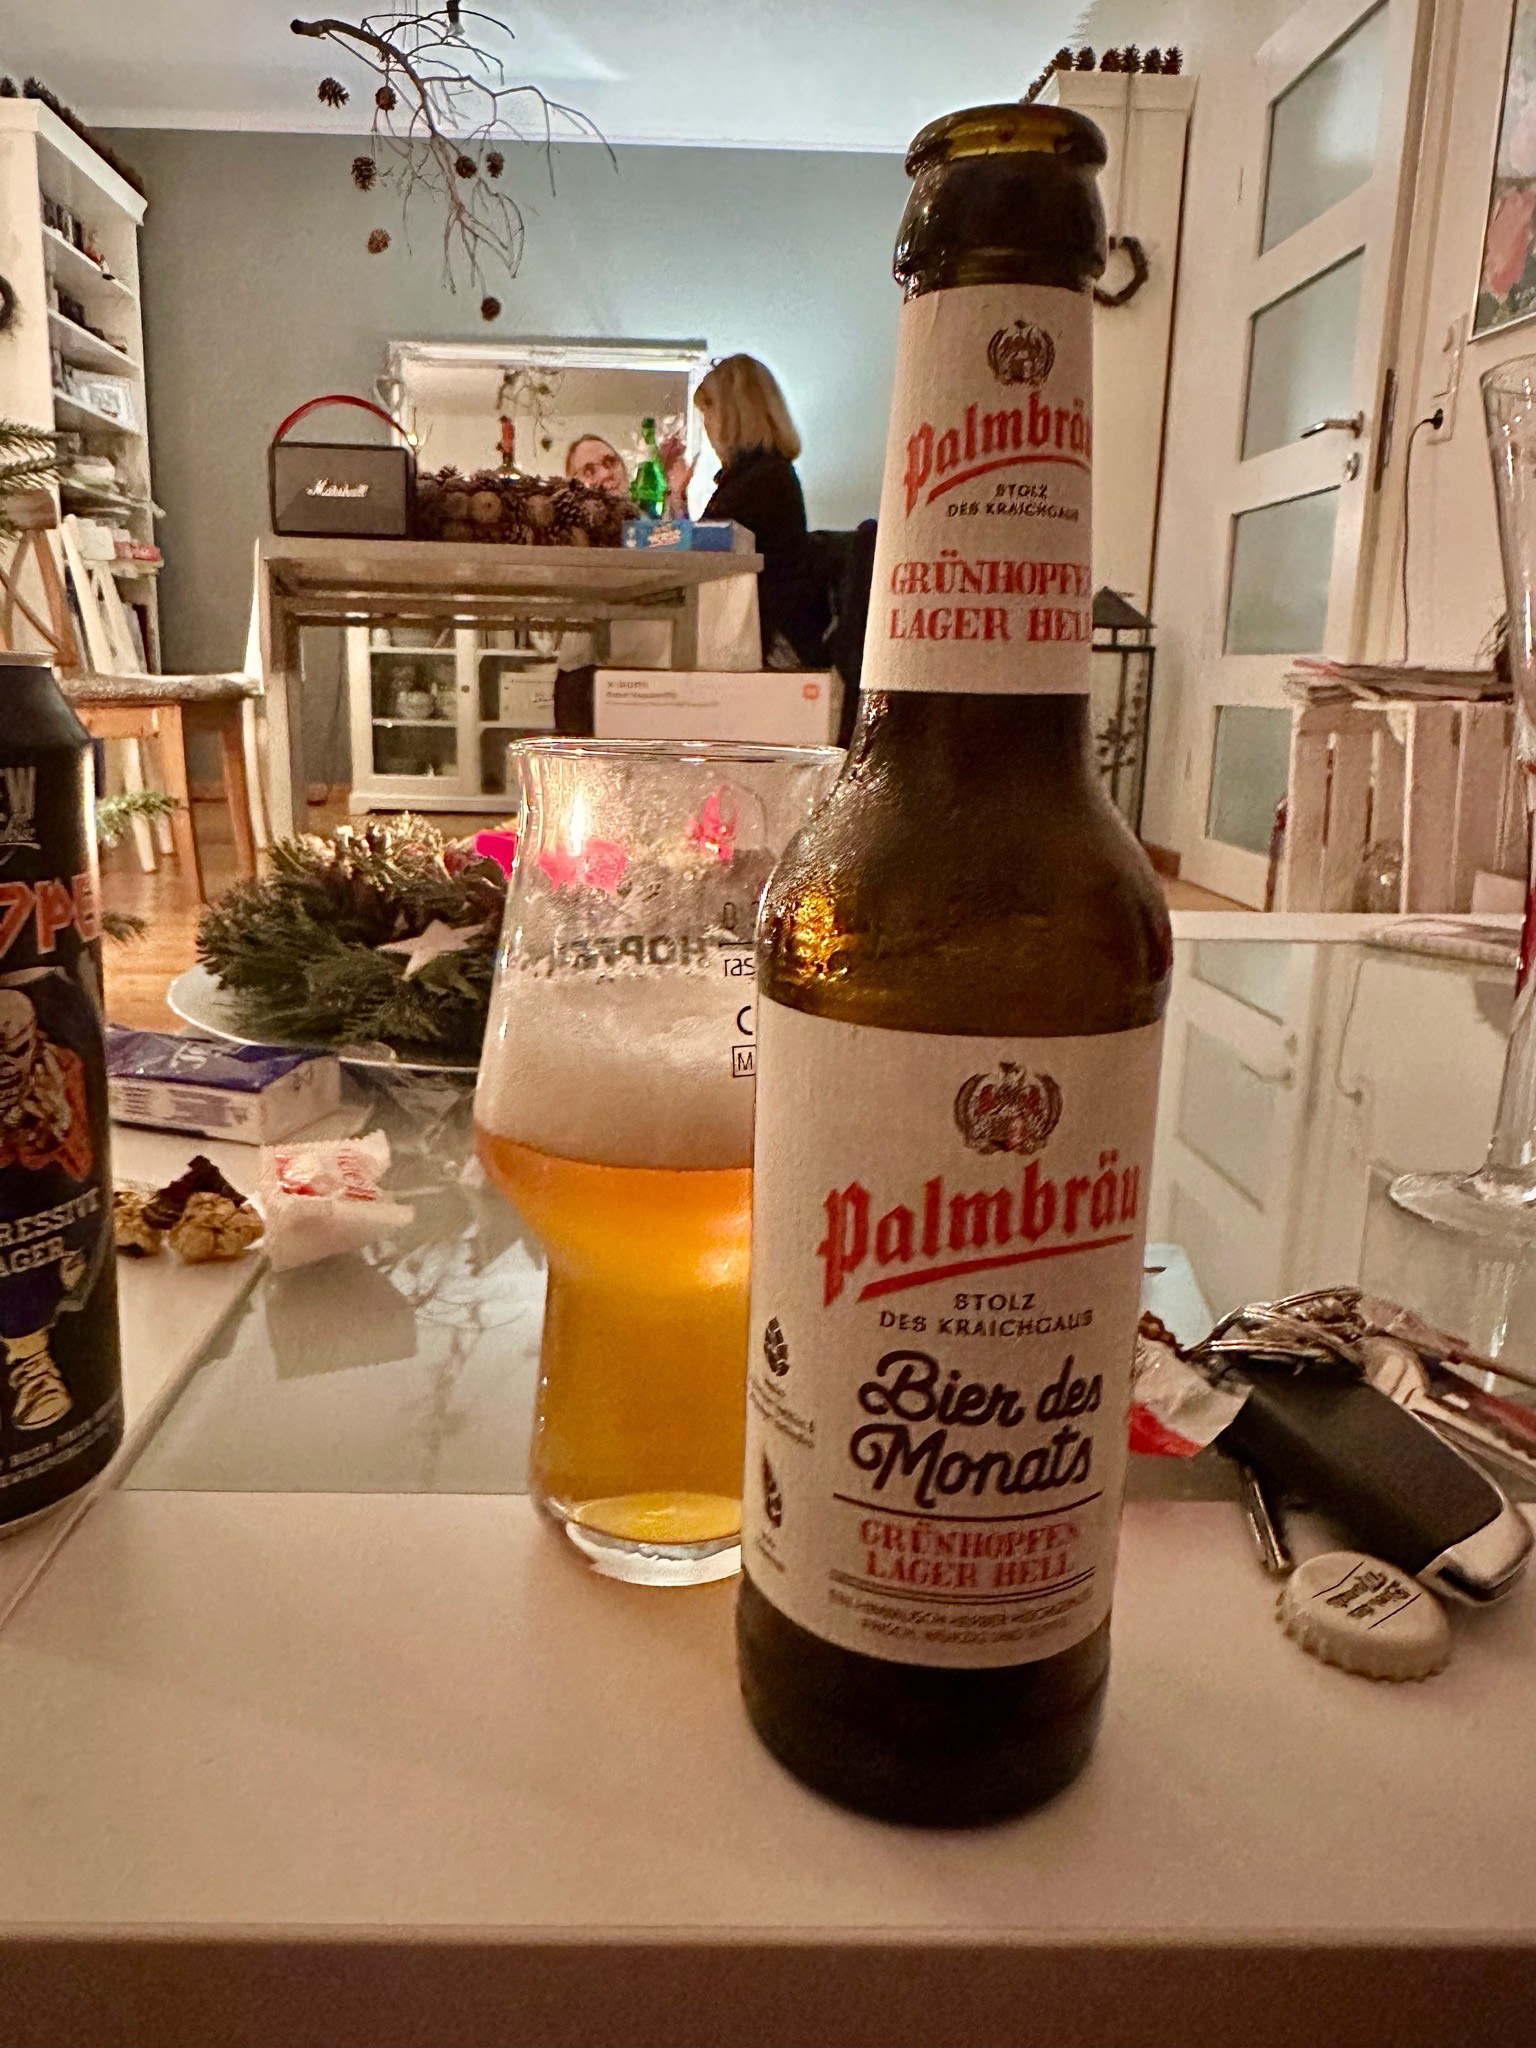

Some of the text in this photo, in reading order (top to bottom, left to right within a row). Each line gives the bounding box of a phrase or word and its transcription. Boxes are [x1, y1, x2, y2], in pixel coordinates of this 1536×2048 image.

[890, 606, 1012, 641] LAGER
[816, 1149, 1141, 1307] Palmbräu
[953, 1293, 1036, 1311] STOLZ
[879, 1309, 1094, 1338] DES KRAICHGAUS
[858, 1350, 1029, 1428] Bier
[1036, 1354, 1104, 1423] des
[849, 1423, 1094, 1509] Monats
[866, 1550, 1074, 1588] LAGER HELL
